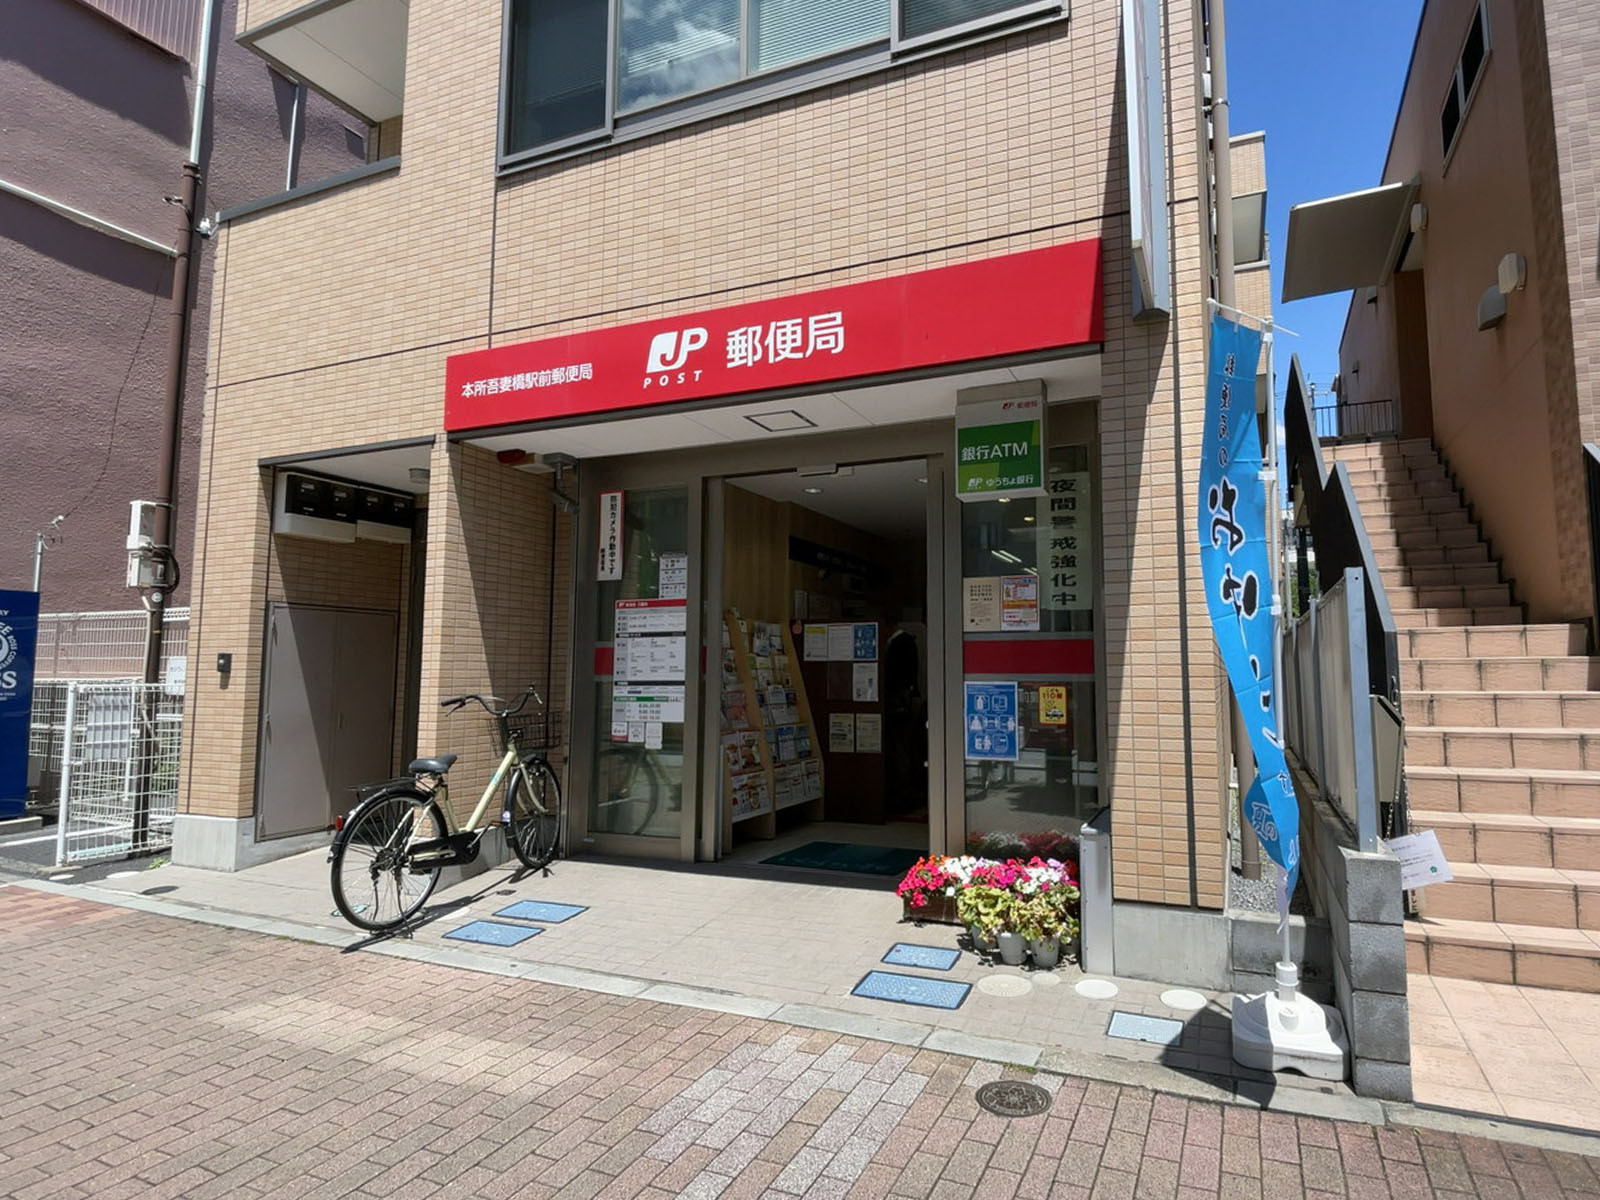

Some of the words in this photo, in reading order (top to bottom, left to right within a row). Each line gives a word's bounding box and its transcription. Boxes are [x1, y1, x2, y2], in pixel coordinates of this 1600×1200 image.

[726, 311, 844, 369] 郵便局
[461, 362, 593, 399] 本所吾妻橋駅前郵便局
[643, 370, 702, 389] POST
[962, 441, 1028, 461] 銀行ATM
[986, 476, 1034, 487] ゆうちょ銀行
[1050, 478, 1077, 605] 夜間警戒強化中
